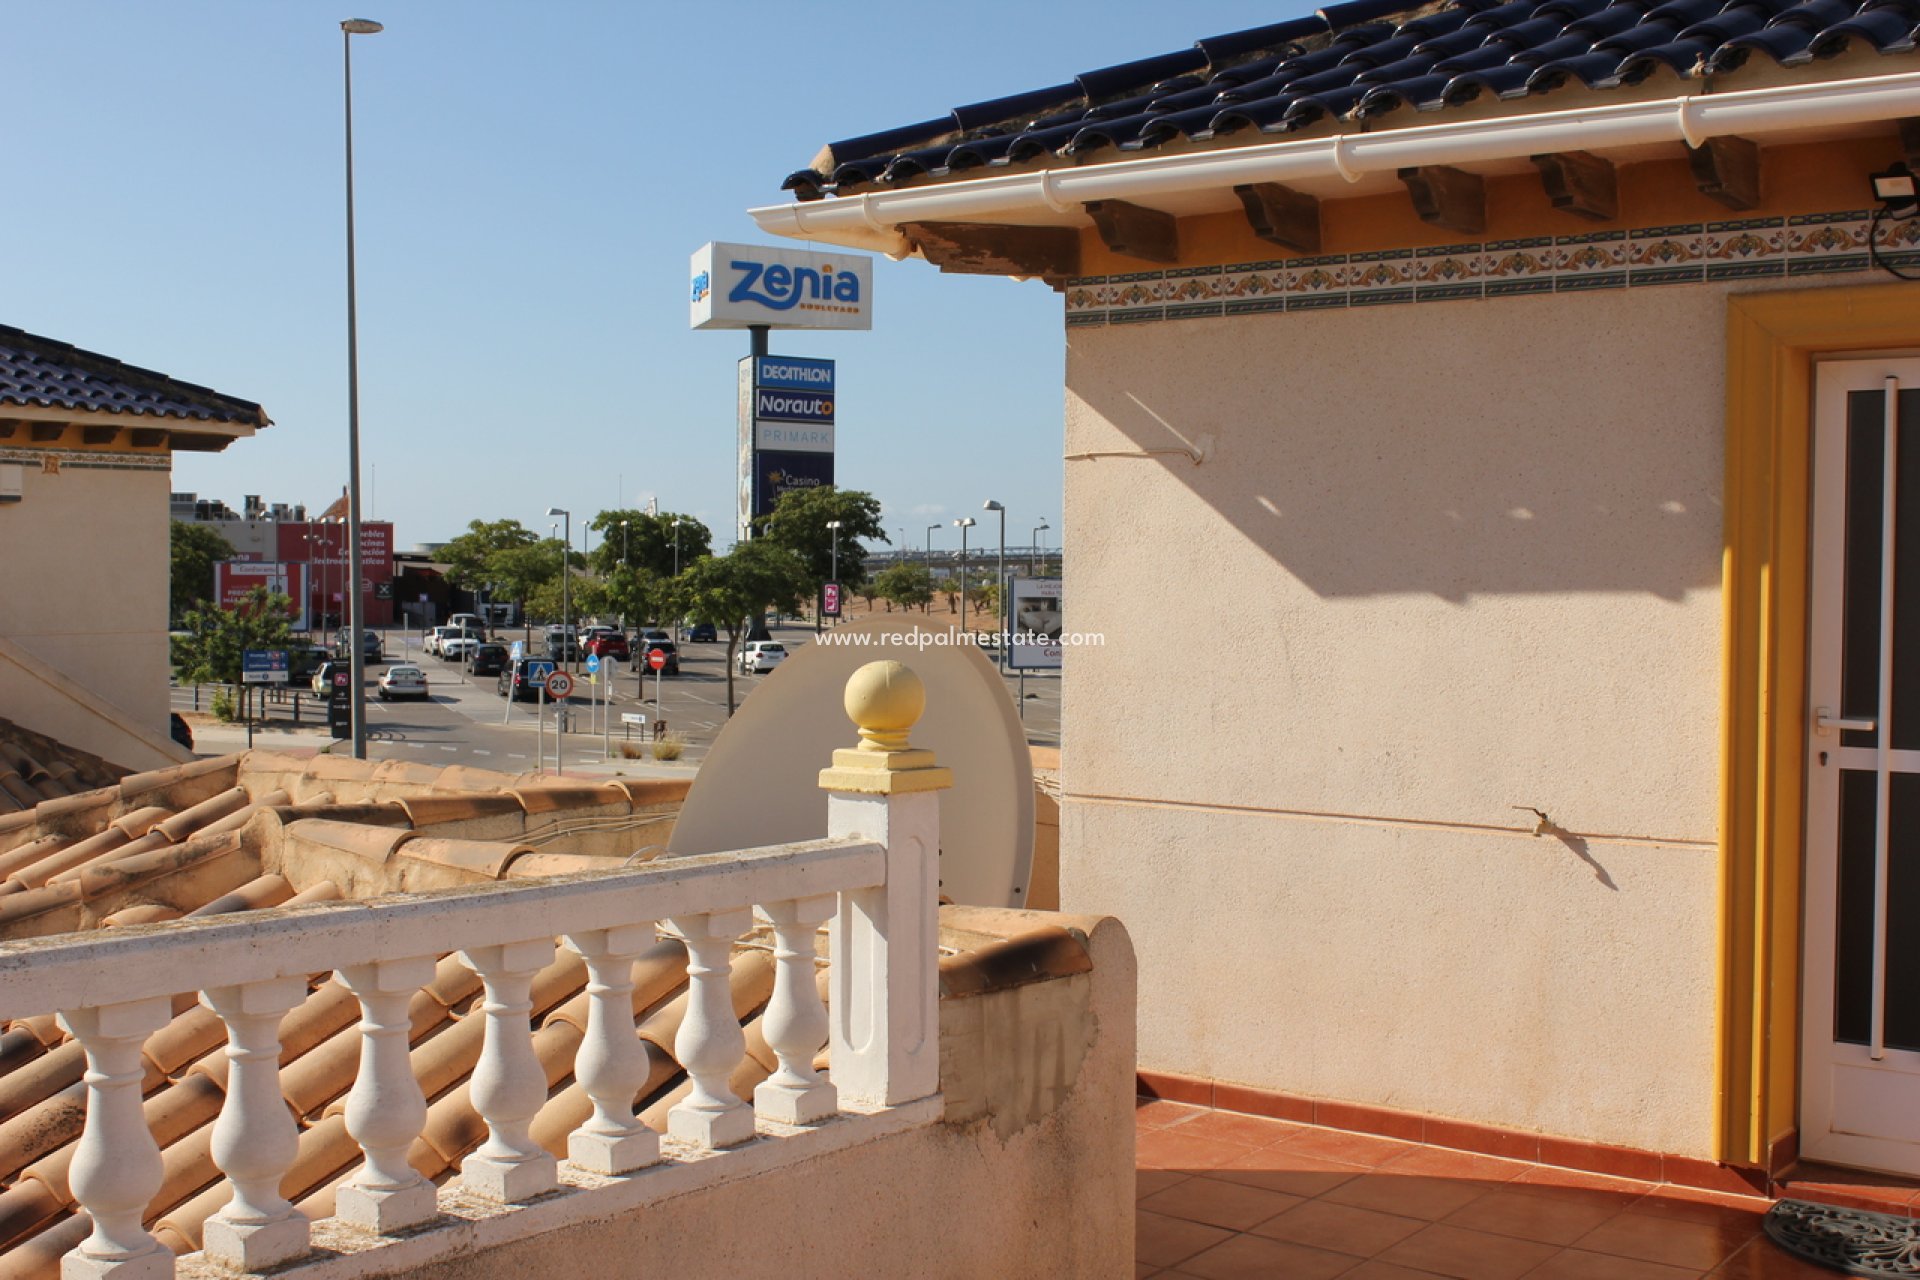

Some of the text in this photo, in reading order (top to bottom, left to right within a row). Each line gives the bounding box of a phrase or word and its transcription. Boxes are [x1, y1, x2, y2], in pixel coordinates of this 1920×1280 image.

[763, 365, 831, 382] DECATHLON
[760, 396, 832, 415] Norauto
[763, 429, 829, 443] PRIMARK
[785, 475, 820, 486] Casino
[551, 680, 568, 690] 20
